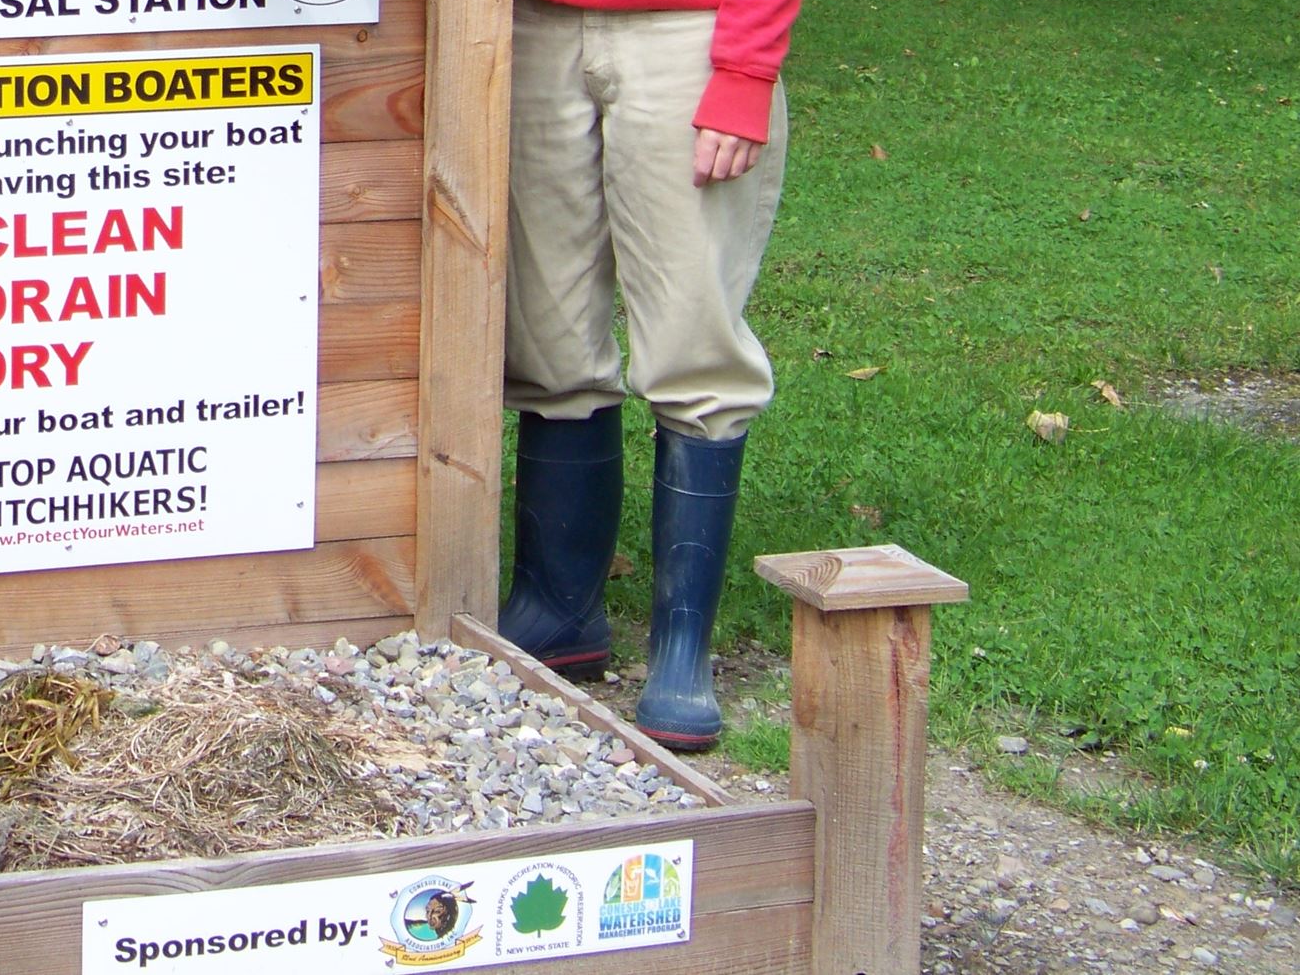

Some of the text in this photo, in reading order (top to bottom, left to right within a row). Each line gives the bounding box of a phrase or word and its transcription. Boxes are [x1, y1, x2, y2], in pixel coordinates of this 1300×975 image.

[104, 64, 304, 104] BOATERS
[140, 128, 214, 158] your
[227, 120, 302, 147] boat
[88, 163, 150, 190] this
[163, 161, 236, 187] site:
[38, 405, 113, 433] boat
[125, 400, 185, 426] and
[197, 391, 304, 421] trailer!
[66, 446, 207, 486] AQUATIC
[497, 888, 509, 915] PARKS
[600, 901, 646, 915] CONESUS
[496, 918, 503, 928] OF
[599, 923, 682, 939] MANAGEMENT PROGRAM
[600, 908, 681, 931] WATERSHED
[115, 918, 368, 967] Sponsored by:
[507, 941, 570, 955] NEW YORK STATE
